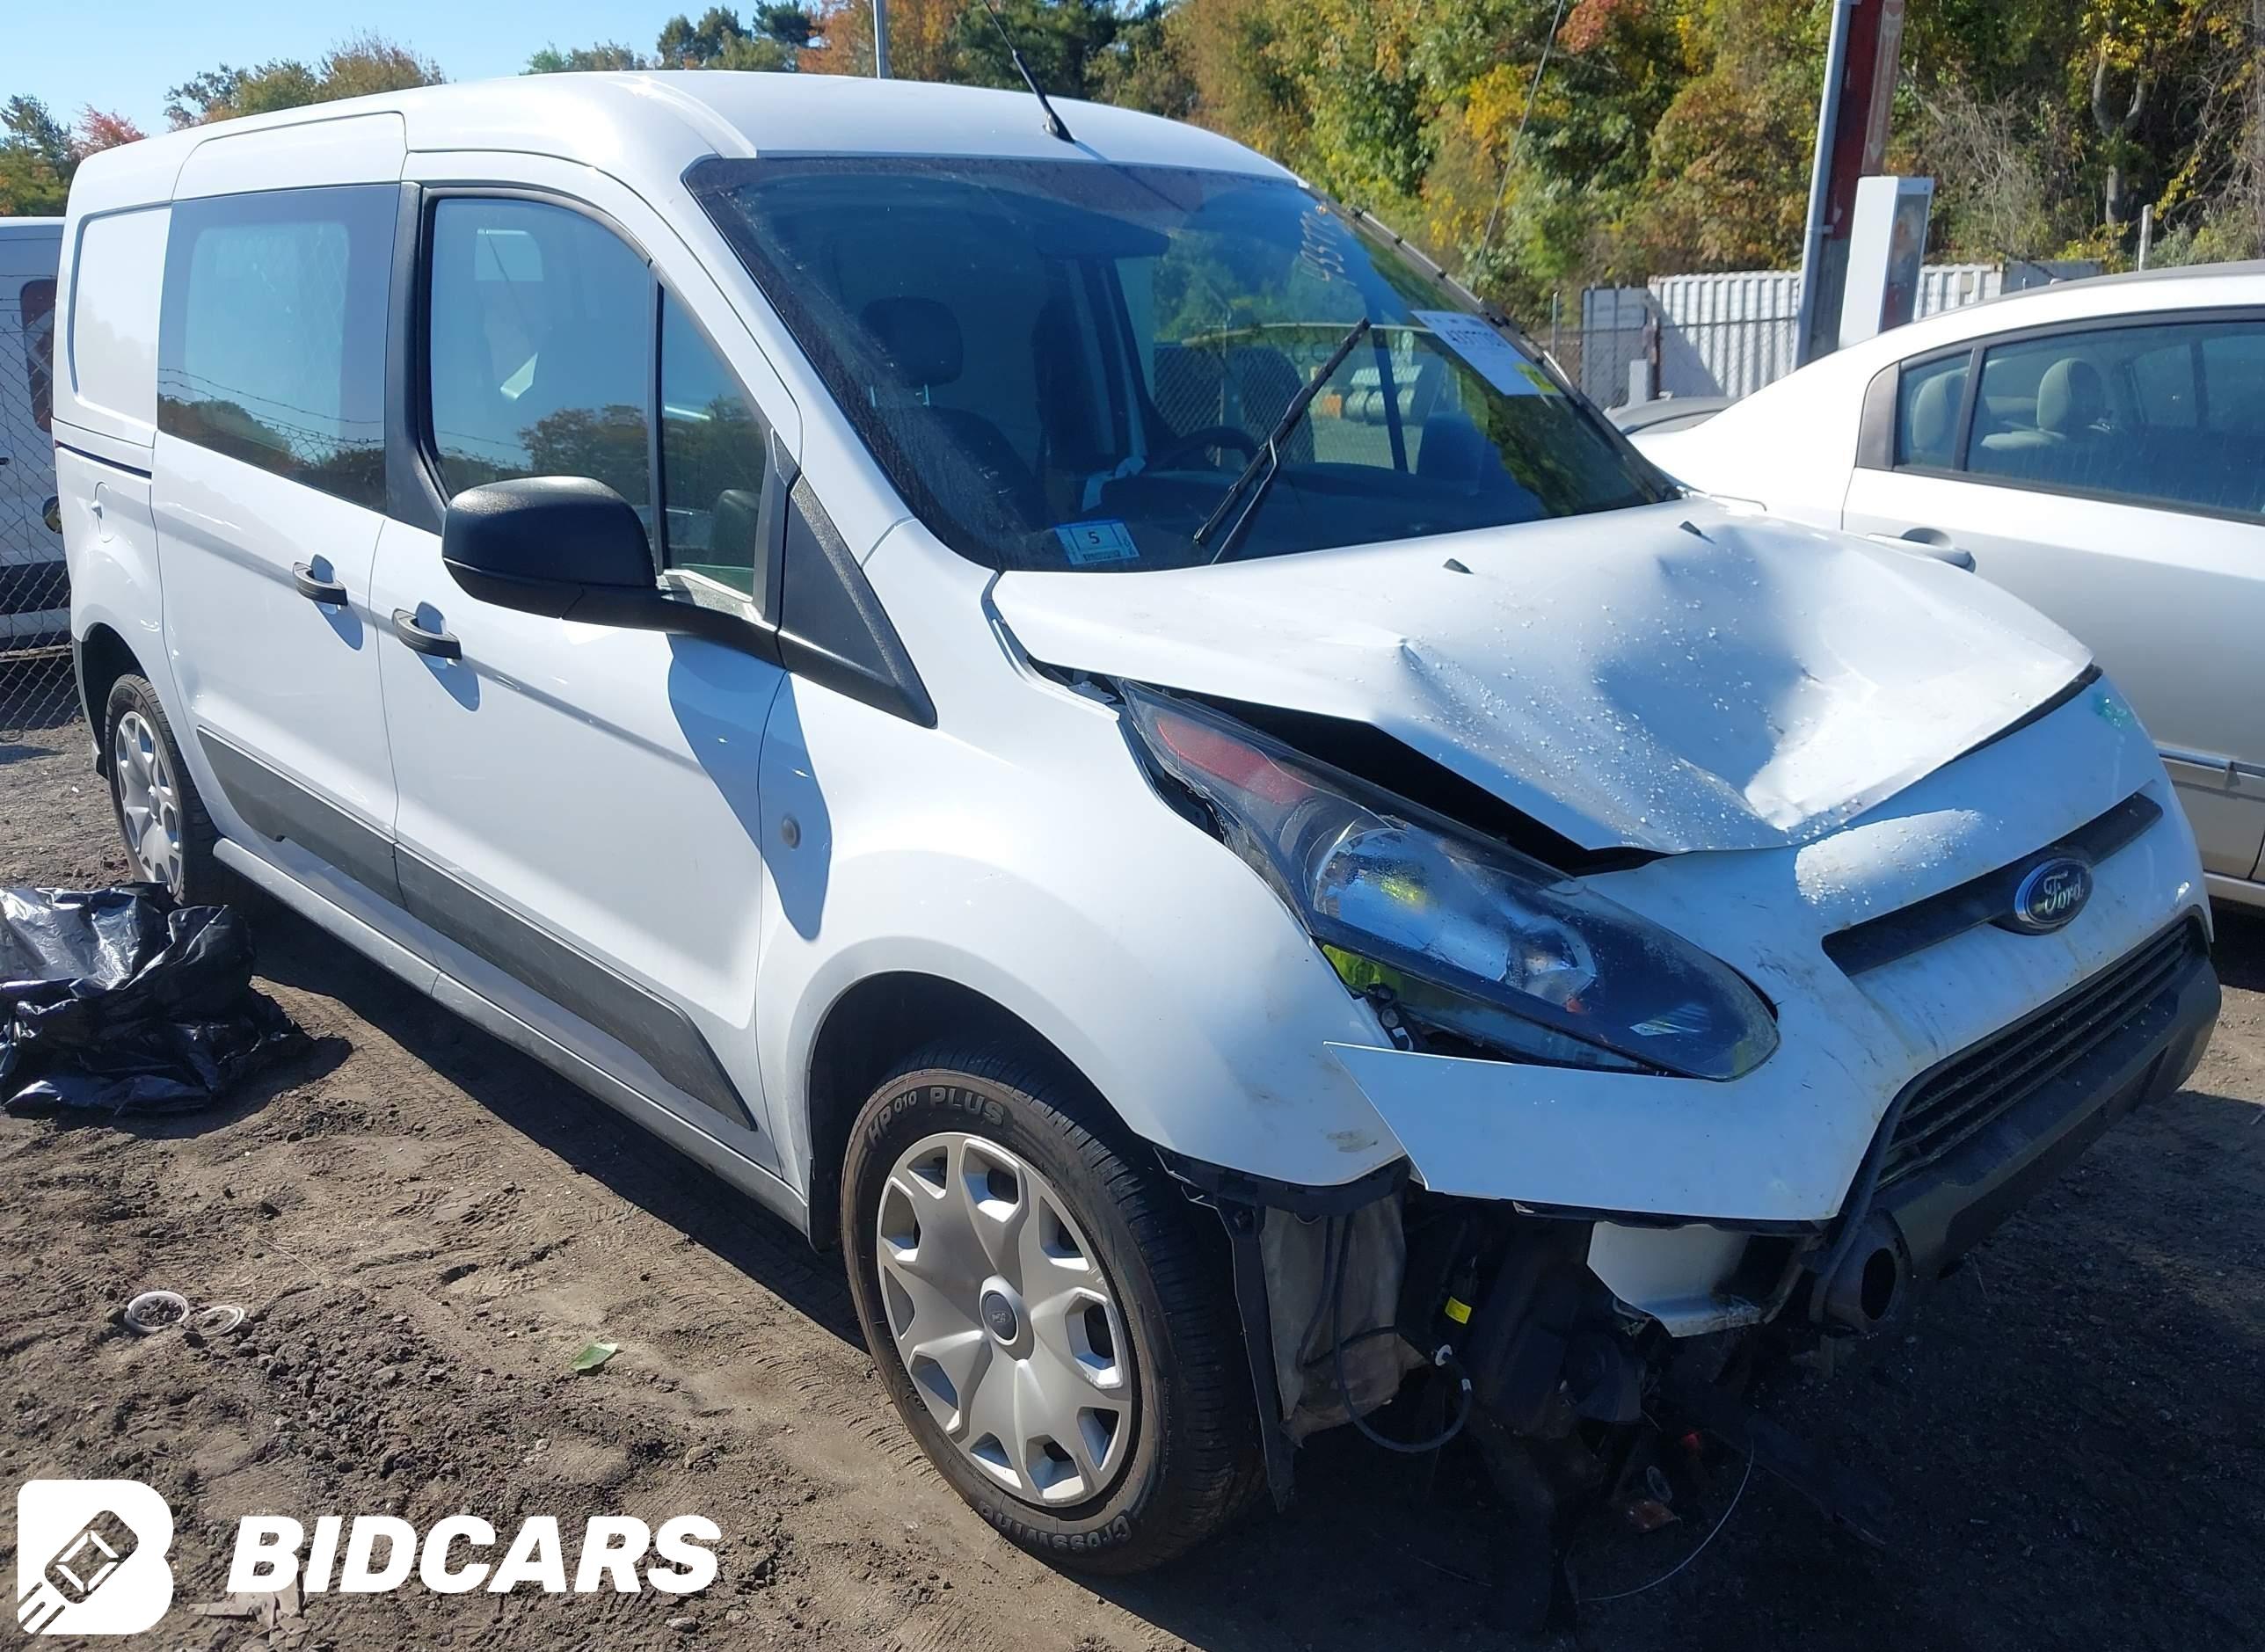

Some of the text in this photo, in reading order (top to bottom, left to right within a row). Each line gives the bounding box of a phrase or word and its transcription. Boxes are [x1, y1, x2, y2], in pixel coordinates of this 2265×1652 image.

[1088, 531, 1101, 544] 5
[2043, 870, 2084, 915] Ford
[929, 1087, 1006, 1126] PLUS
